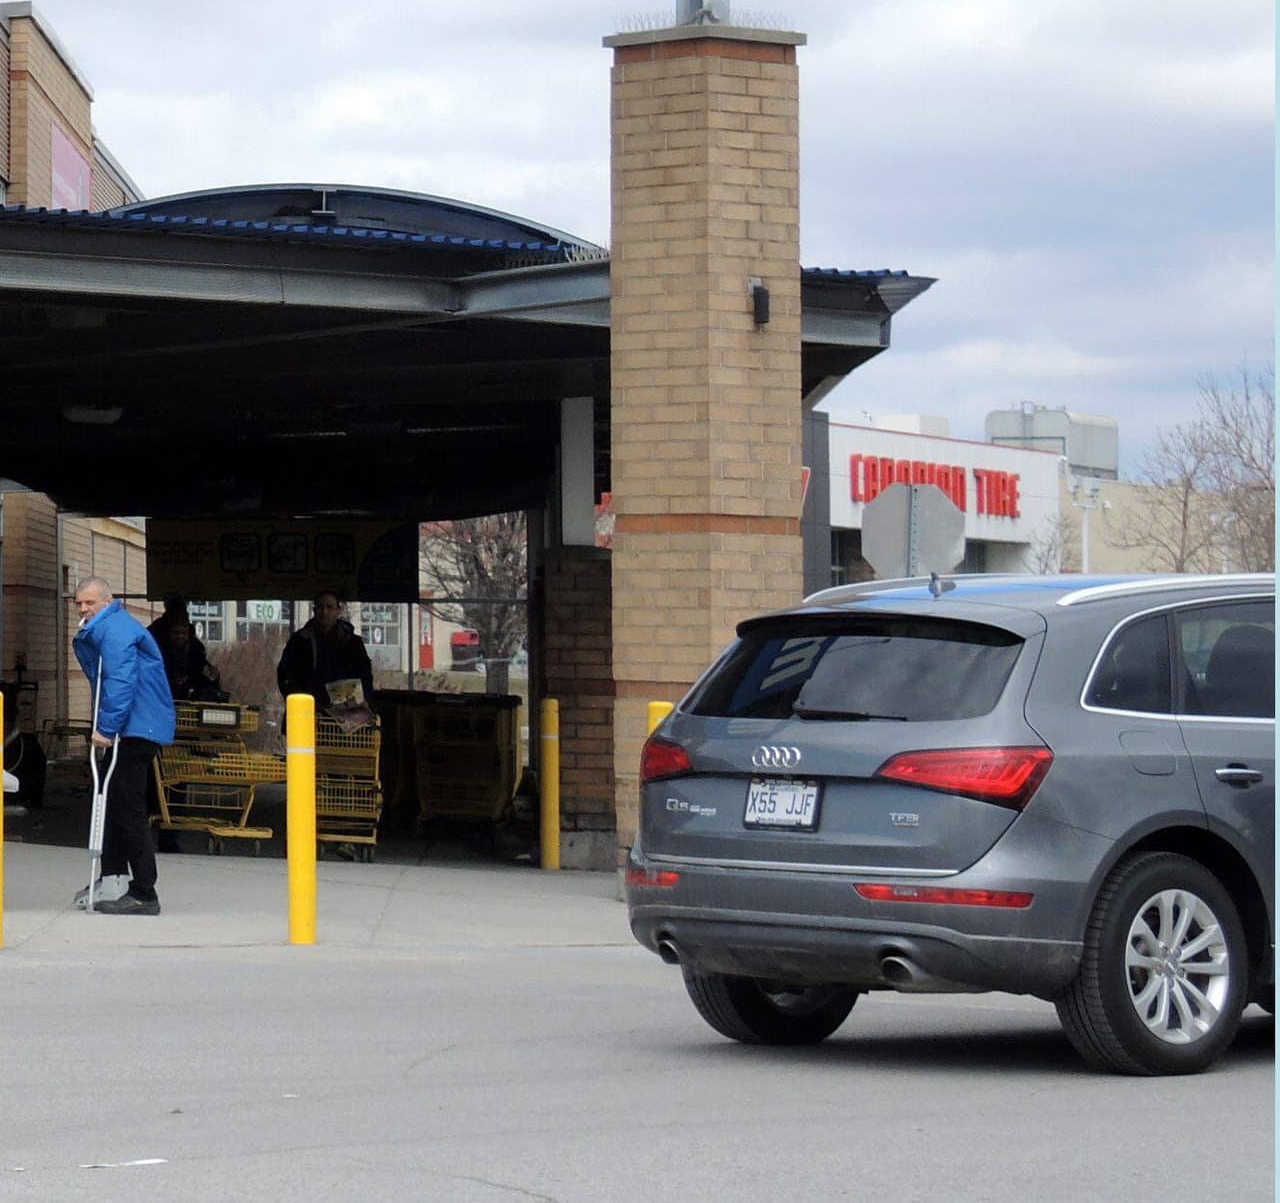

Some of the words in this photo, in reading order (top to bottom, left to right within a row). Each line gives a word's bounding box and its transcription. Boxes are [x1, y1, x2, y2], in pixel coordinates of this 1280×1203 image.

[973, 467, 1021, 519] TIRE
[255, 604, 274, 619] ECO
[748, 791, 778, 813] X55
[785, 793, 815, 815] JJF
